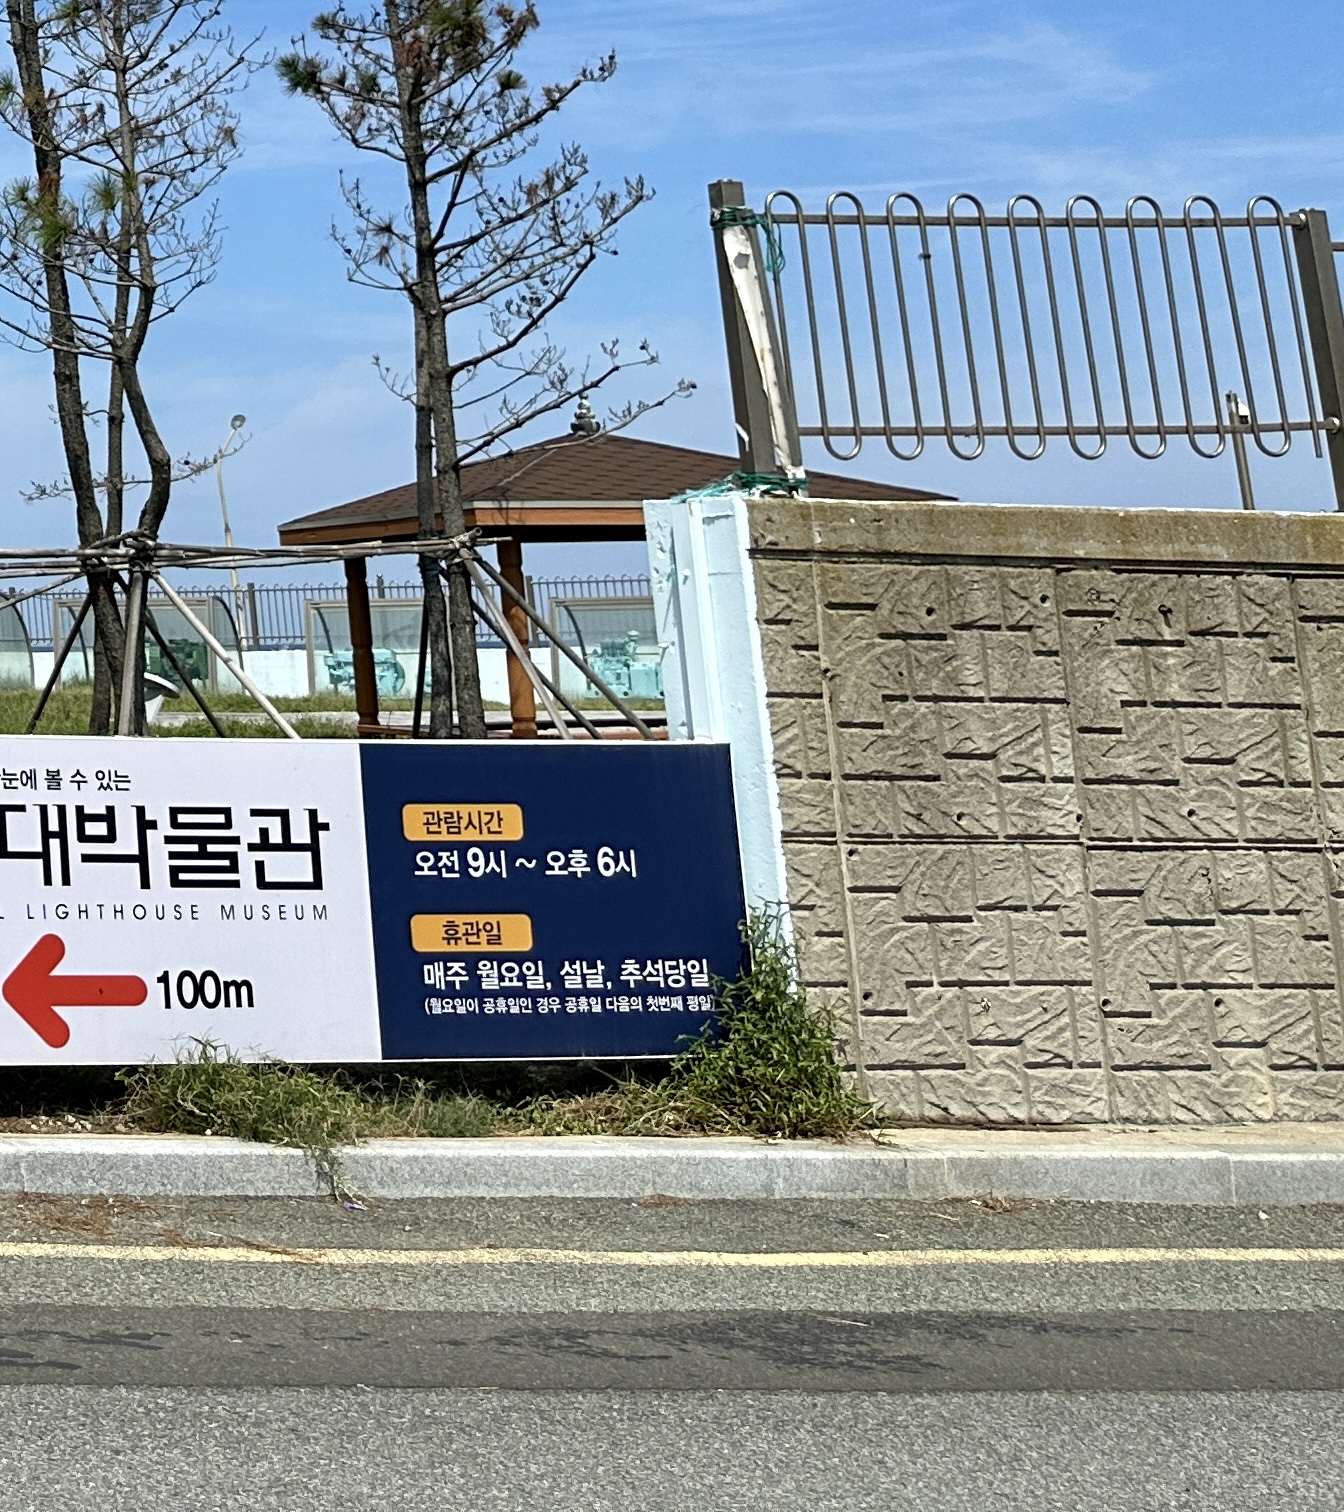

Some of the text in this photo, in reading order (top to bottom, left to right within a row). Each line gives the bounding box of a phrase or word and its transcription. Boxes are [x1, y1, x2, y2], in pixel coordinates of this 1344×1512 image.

[44, 768, 63, 791] 볼
[69, 768, 88, 792] 수
[95, 769, 132, 792] 있는
[422, 810, 504, 836] 관람시간
[414, 849, 461, 878] 오전
[466, 846, 507, 879] 9시
[545, 849, 591, 878] 오후
[596, 846, 637, 878] 6시
[26, 903, 199, 921] LIGHTHOUSE
[220, 904, 328, 921] MUSEUM
[441, 920, 503, 946] 휴관일
[423, 958, 710, 991] 매주 월요일, 설날, 추석당일
[156, 969, 255, 1010] 100m
[424, 997, 480, 1016] (월요일이
[482, 996, 533, 1014] 공휴일인
[535, 996, 562, 1014] 경우
[564, 996, 603, 1014] 공휴일
[605, 995, 643, 1013] 다음의
[646, 995, 684, 1012] 첫번째
